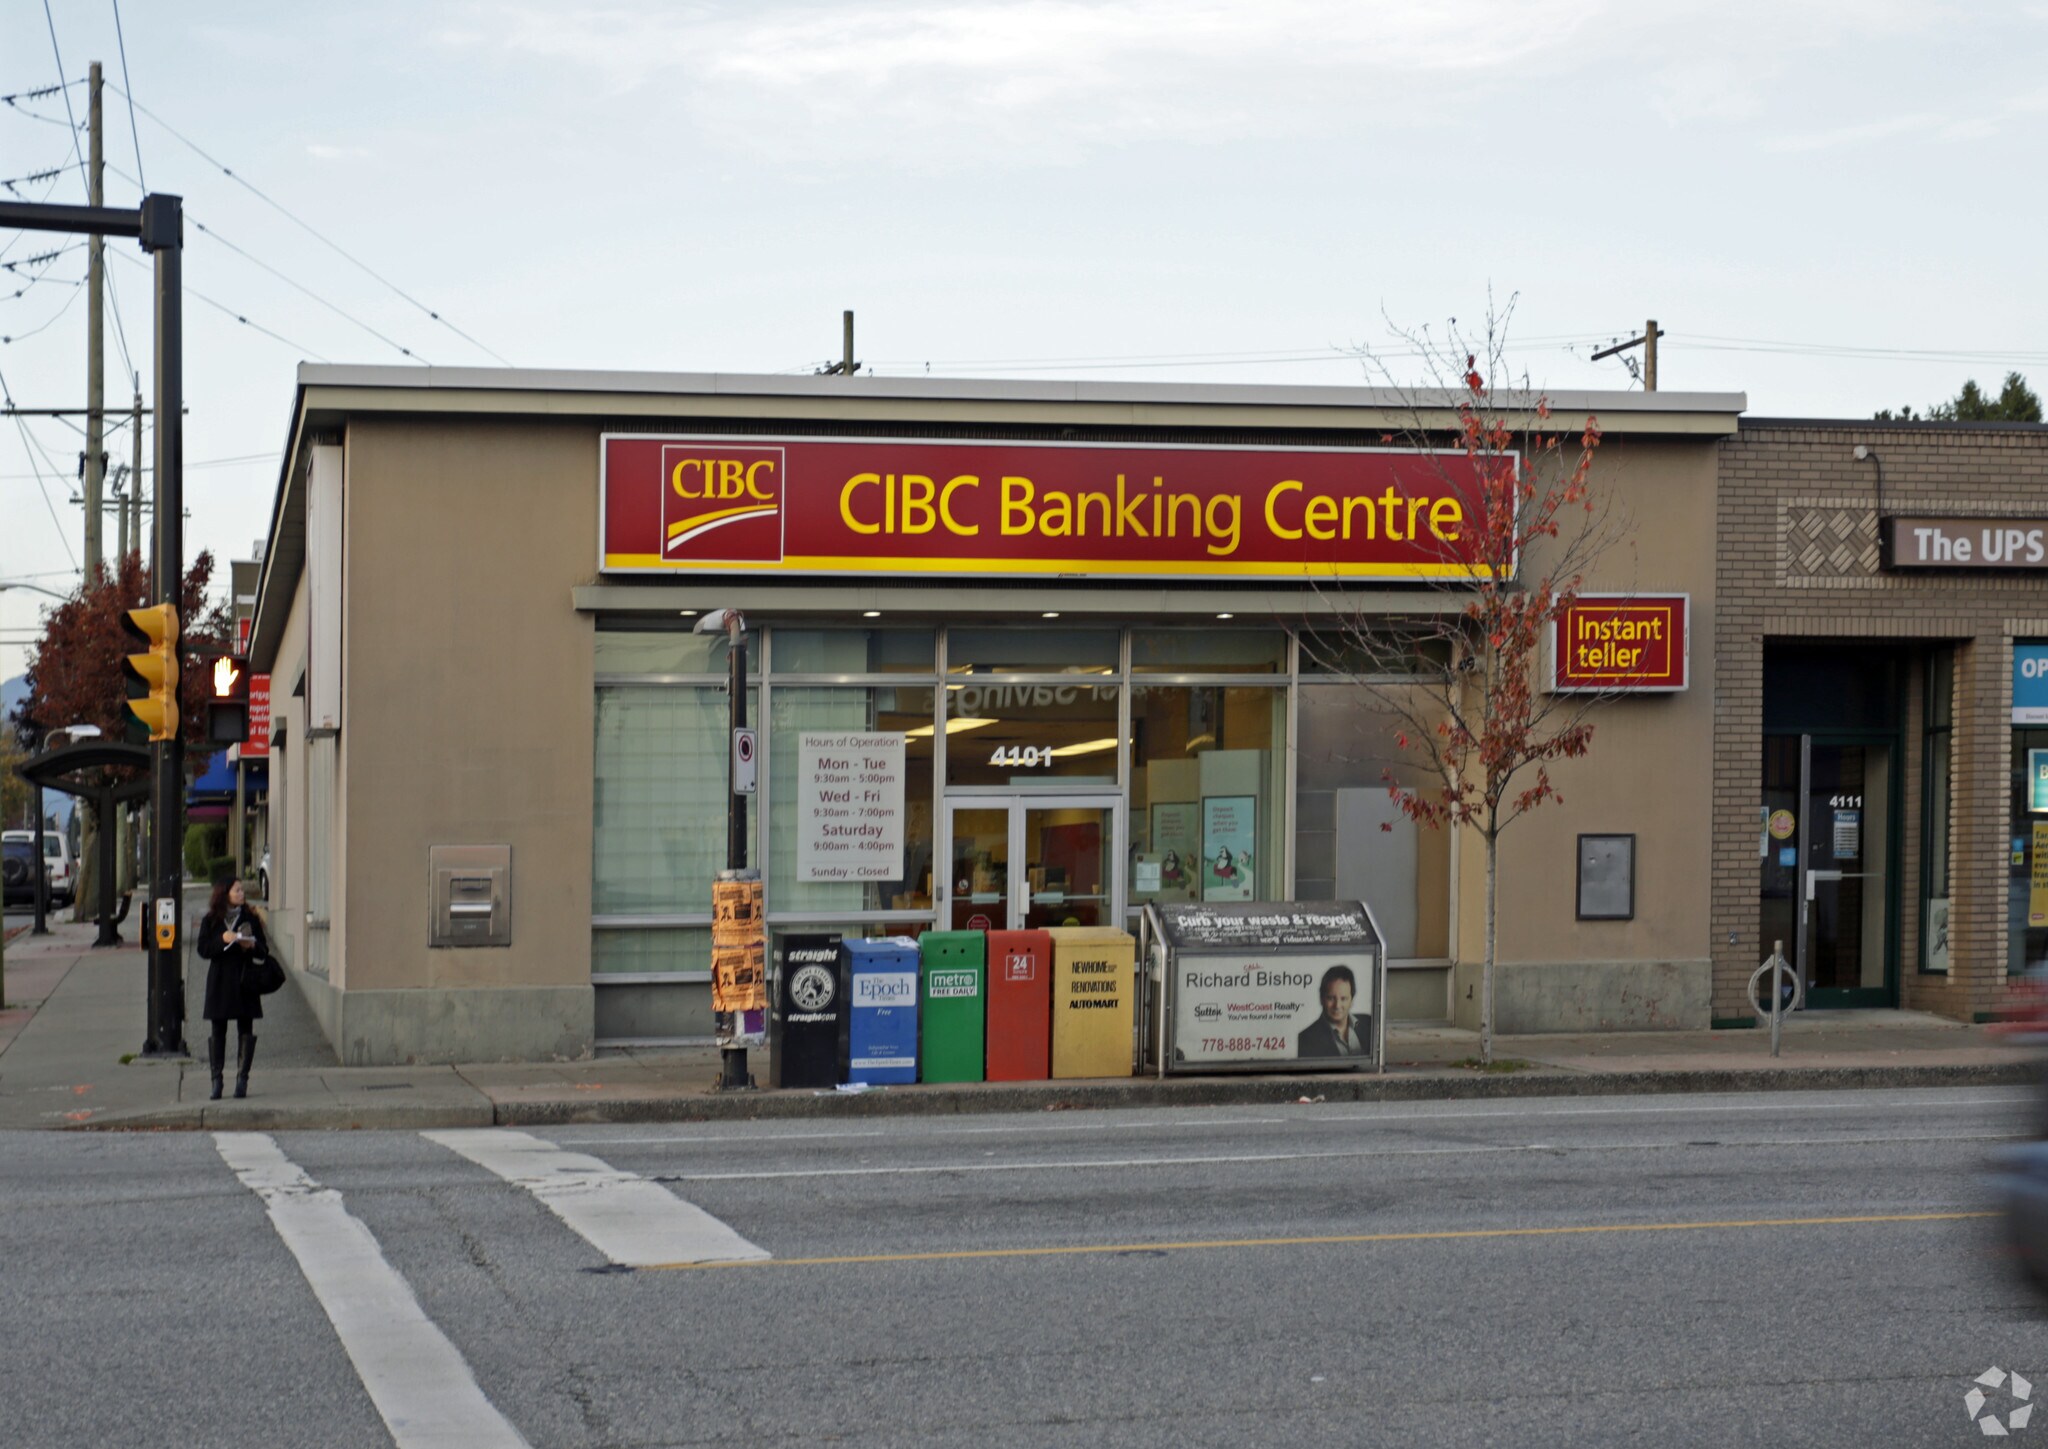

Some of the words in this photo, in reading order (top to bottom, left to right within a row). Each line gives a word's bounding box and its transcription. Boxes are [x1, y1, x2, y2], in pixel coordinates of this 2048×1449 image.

[672, 458, 775, 500] CIBC
[839, 473, 980, 536] CIBC
[1000, 474, 1242, 556] Banking
[1264, 480, 1464, 541] Centre
[1914, 528, 1972, 561] The
[1981, 529, 2045, 562] UPS
[1578, 615, 1662, 641] Instant
[1577, 642, 1642, 668] teller
[805, 737, 834, 747] Hours
[836, 736, 847, 747] of
[849, 736, 899, 749] Operation
[990, 745, 1052, 767] 4101
[818, 758, 849, 770] Mon
[862, 757, 886, 770] Tue
[814, 774, 850, 783] 9:30am
[859, 774, 895, 785] 5:00pm
[819, 790, 850, 802] Wed
[864, 790, 881, 802] Fri
[1829, 795, 1862, 808] 4111
[813, 808, 849, 817] 9:30am
[859, 808, 894, 819] 7:00pm
[822, 823, 884, 838] Saturday
[813, 842, 849, 851] 9:00am
[858, 841, 894, 852] 4:00pm
[811, 867, 848, 880] Sunday
[857, 866, 890, 876] Closed
[1178, 915, 1212, 927] Curb
[1213, 916, 1245, 928] your
[1247, 914, 1290, 926] waste
[1292, 914, 1304, 925] &
[1306, 913, 1356, 927] recycle
[788, 949, 838, 962] straight
[1013, 956, 1028, 970] 24
[934, 973, 974, 986] metro
[1186, 972, 1250, 988] Richard
[1257, 971, 1313, 989] Bishop
[860, 978, 910, 1000] Epoch
[932, 987, 951, 996] FREE
[953, 986, 975, 996] DAILY
[1071, 980, 1117, 993] RENOVATIONS
[877, 1008, 892, 1016] Free
[1194, 1006, 1222, 1018] Sutton
[1227, 1002, 1273, 1012] WestCoast
[1202, 1037, 1286, 1052] 778-888-7424
